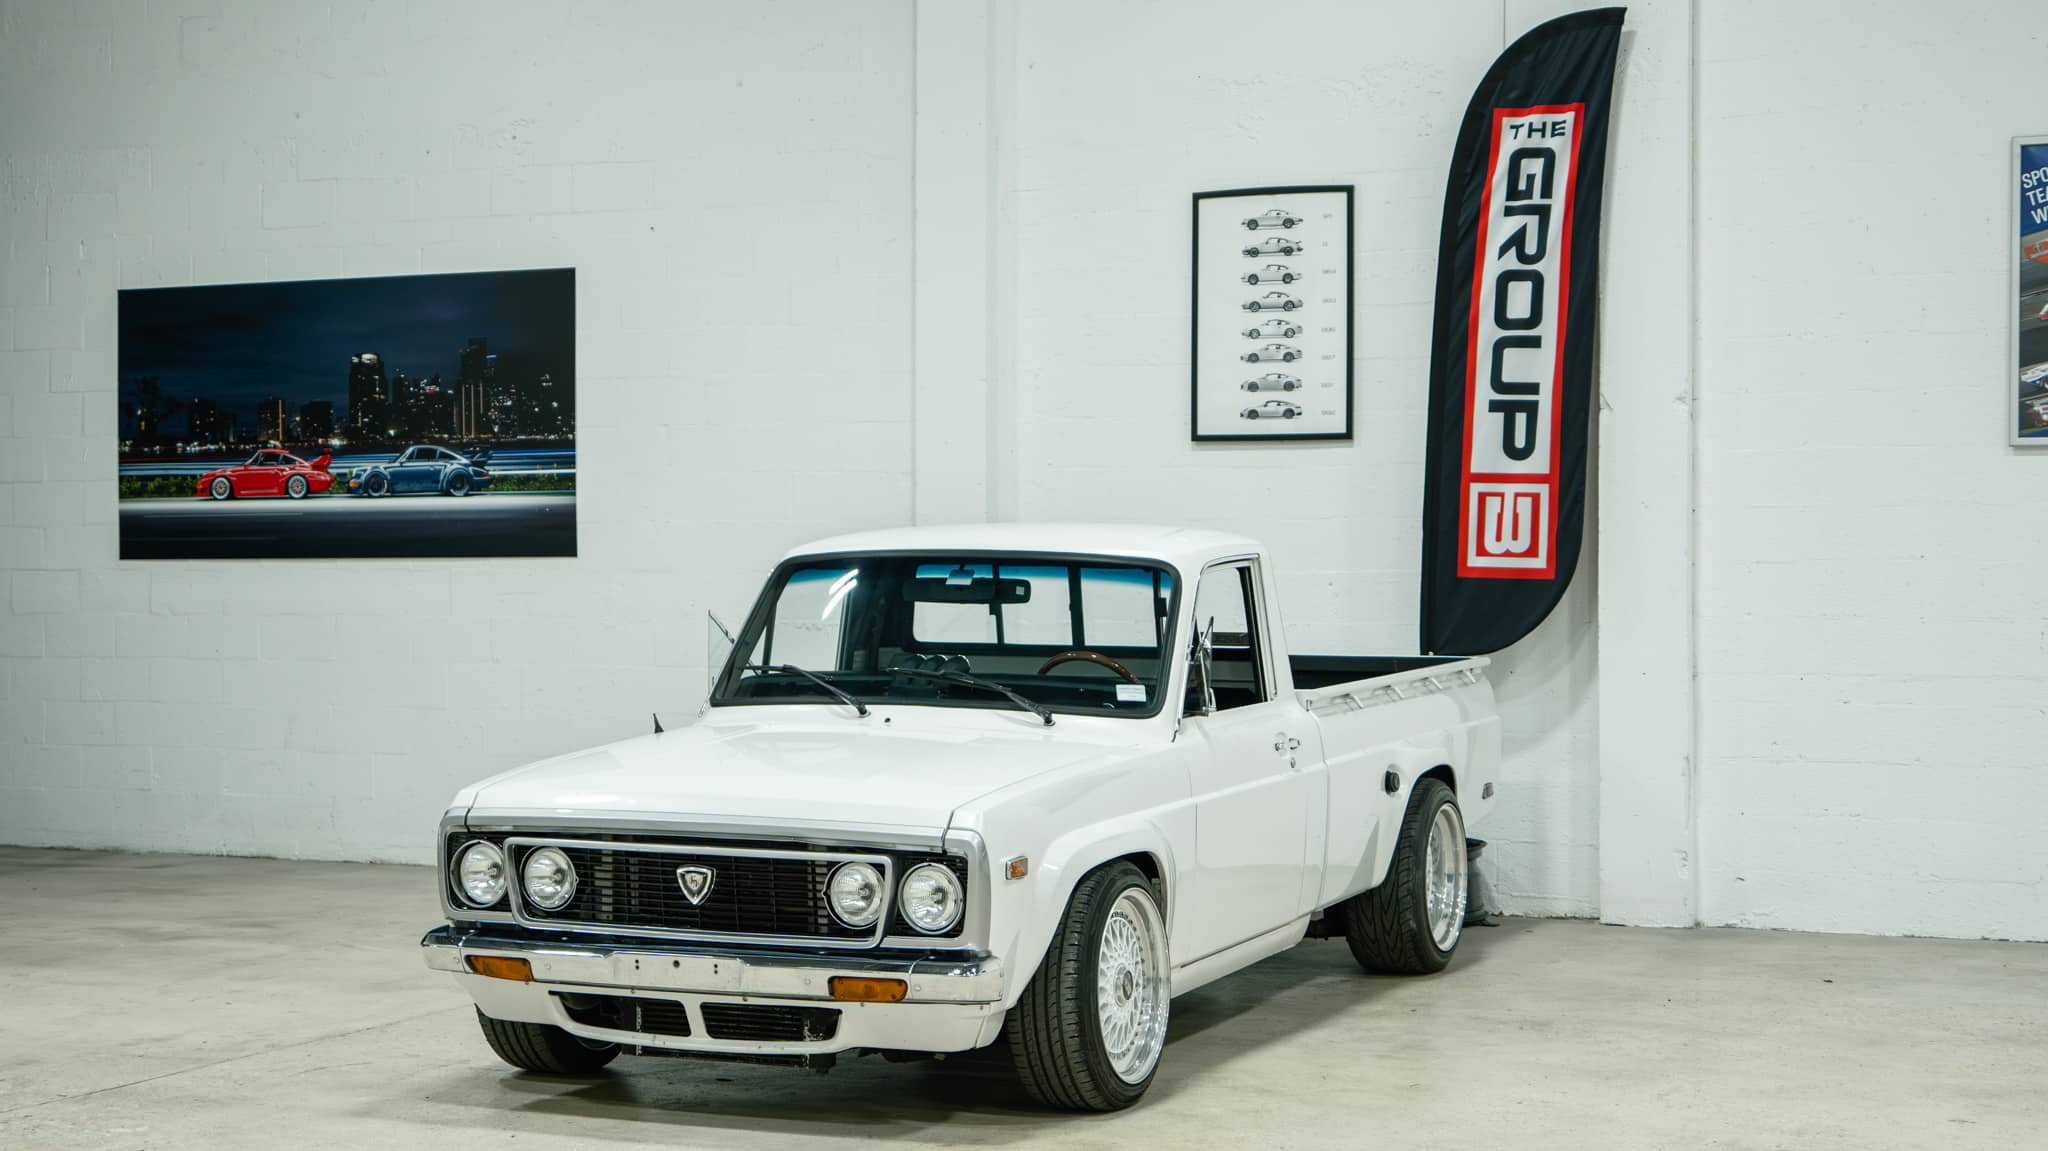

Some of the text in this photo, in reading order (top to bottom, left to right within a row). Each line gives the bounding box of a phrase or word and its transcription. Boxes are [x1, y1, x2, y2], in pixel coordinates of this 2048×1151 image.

[1509, 120, 1567, 140] THE
[2031, 206, 2048, 224] W
[1488, 147, 1556, 461] GROUP
